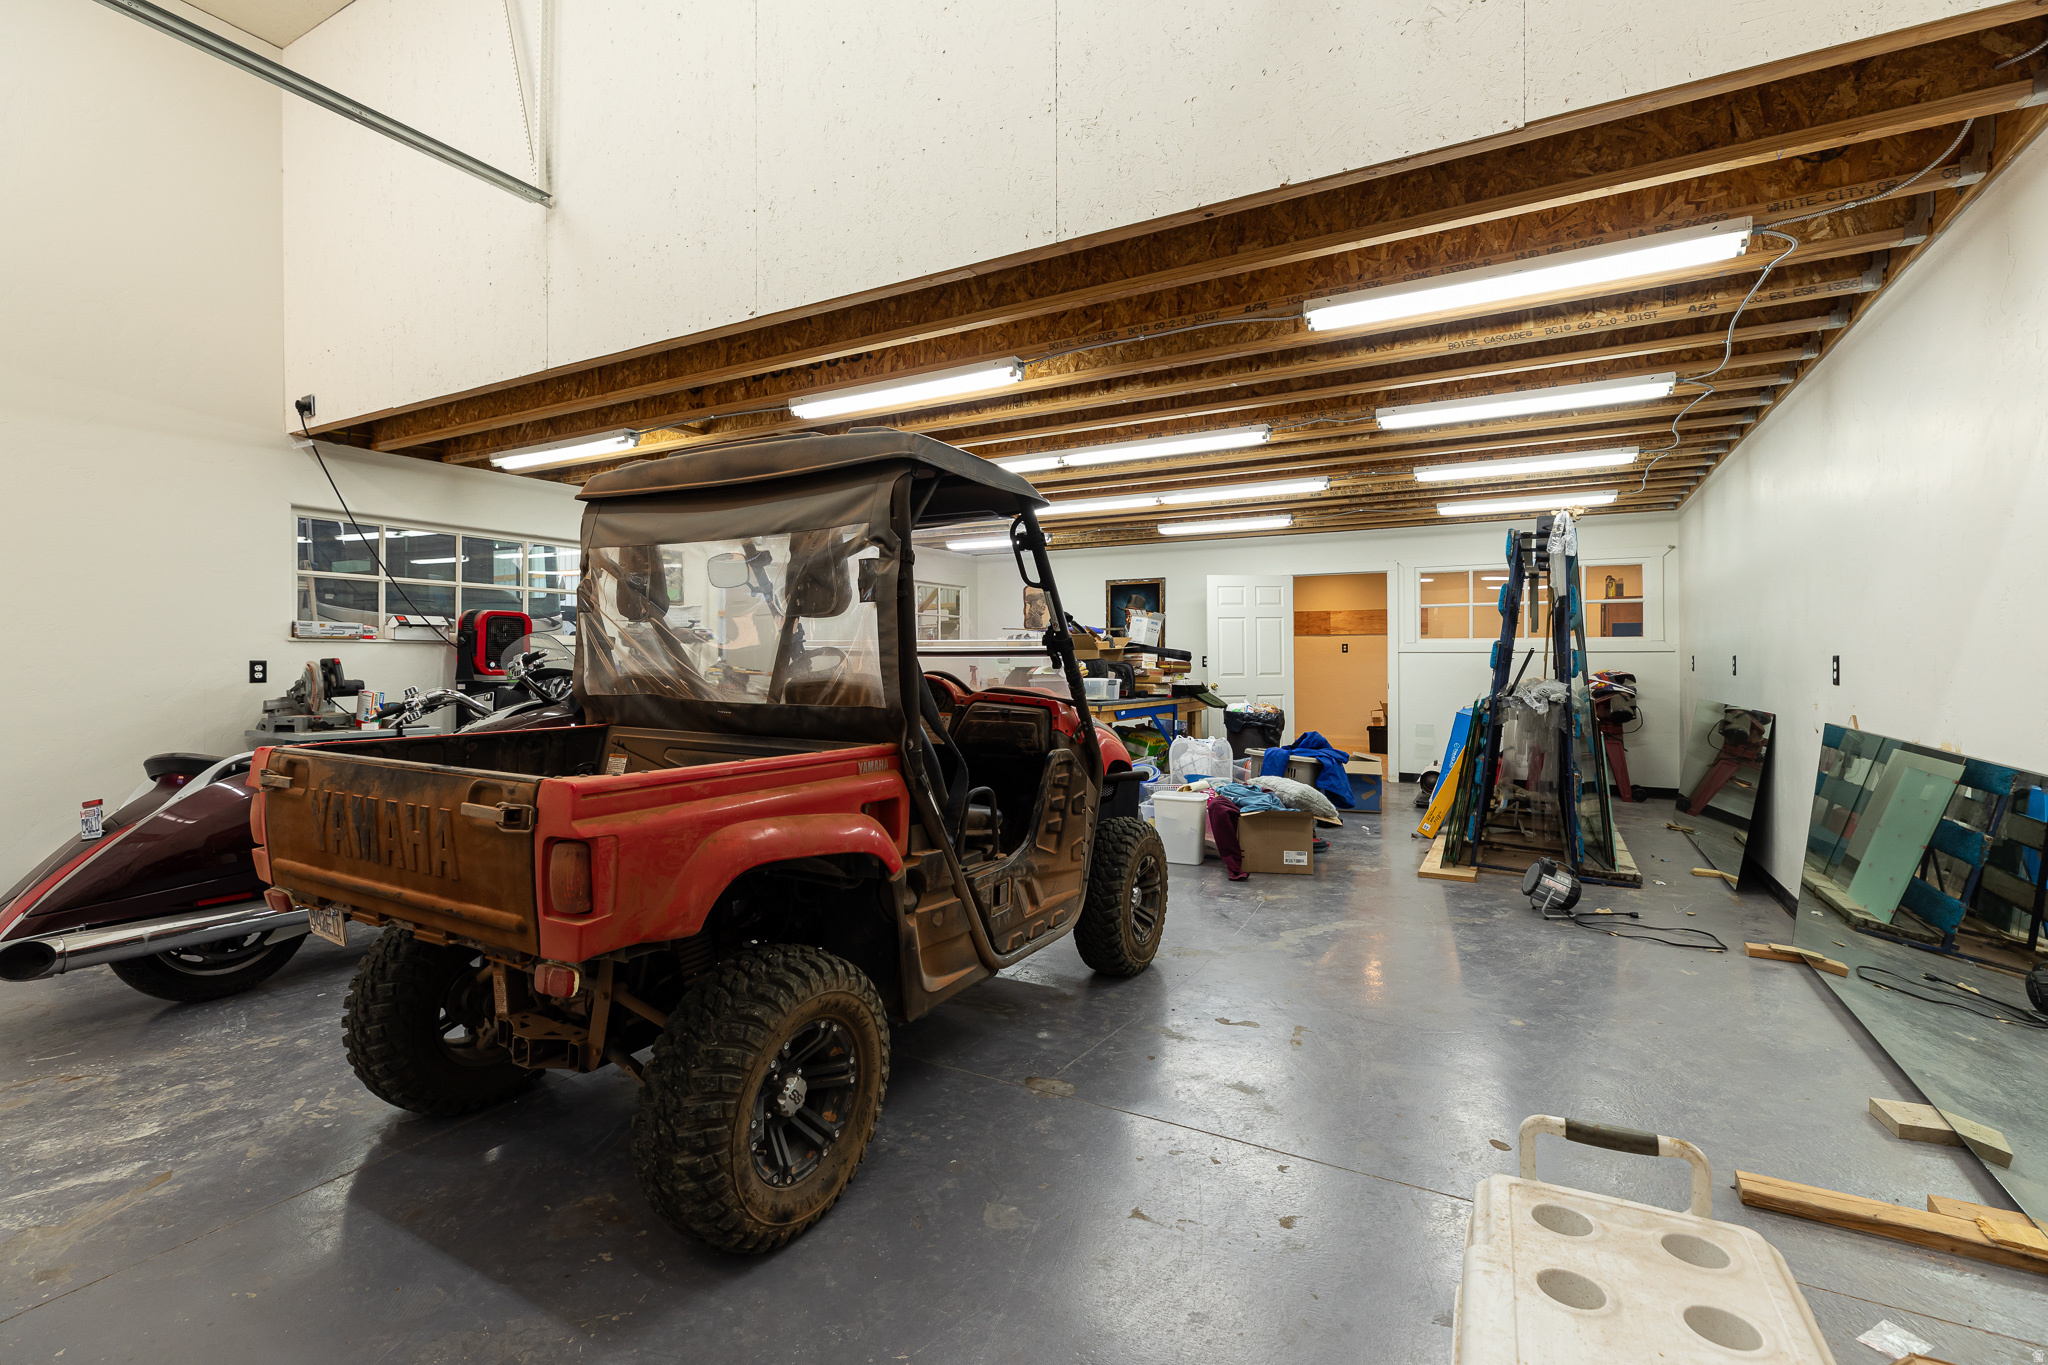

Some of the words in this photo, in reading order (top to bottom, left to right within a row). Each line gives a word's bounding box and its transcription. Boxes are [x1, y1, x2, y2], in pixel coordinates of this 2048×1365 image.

[1048, 339, 1073, 350] BOISE
[1169, 317, 1187, 327] 2.0
[1191, 311, 1221, 323] JOIST
[1244, 301, 1268, 313] APA
[1766, 195, 1817, 214] WHITE
[1447, 338, 1479, 350] BOISE
[1577, 321, 1591, 330] 60
[1596, 317, 1617, 327] 2.0
[1623, 310, 1659, 323] JOIST
[1768, 290, 1787, 301] ES
[1793, 285, 1818, 298] ESR
[1826, 278, 1860, 293] 1336
[857, 758, 889, 774] YAMAHA
[310, 787, 461, 881] YAMAHA
[788, 1089, 804, 1105] SS
